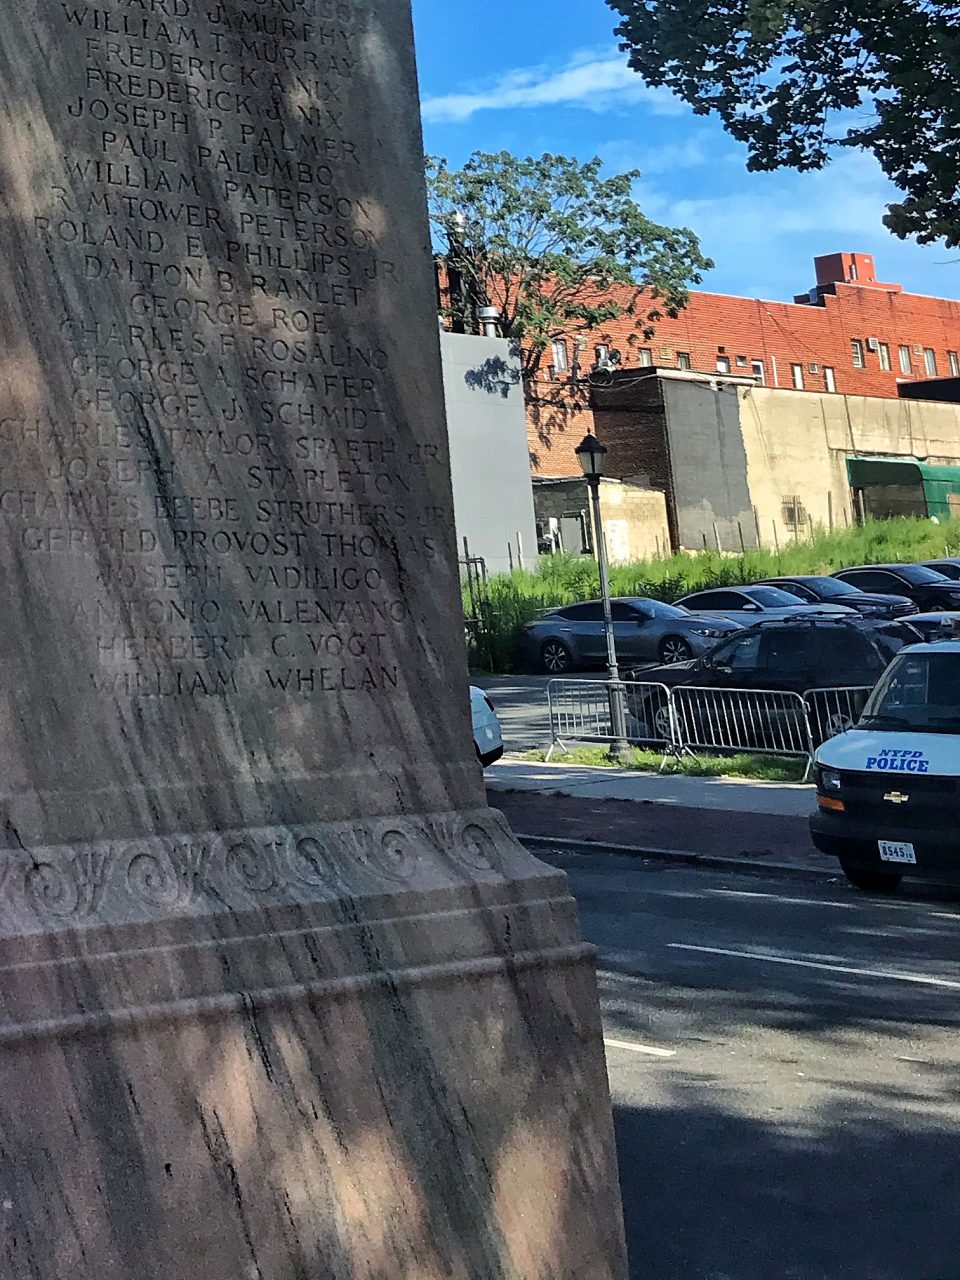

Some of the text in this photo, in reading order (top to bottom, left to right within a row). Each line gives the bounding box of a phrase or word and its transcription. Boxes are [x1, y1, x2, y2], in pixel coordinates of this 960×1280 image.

[60, 1, 200, 51] WILLIAM
[238, 37, 360, 82] MURRAY
[238, 9, 357, 54] MURPHY
[85, 36, 259, 90] FREDERICK
[295, 76, 342, 106] NIX
[85, 66, 254, 117] FREDERICK
[297, 104, 345, 133] NIX
[67, 94, 189, 134] JOSEPH
[239, 123, 361, 163] PALMER
[101, 131, 334, 188] PAUL PALUMBO
[63, 156, 371, 222] WILLIAM PATERSON
[34, 215, 164, 254] ROLAND
[225, 239, 351, 277] PHILLIPS
[122, 196, 225, 230] TOWER
[238, 213, 383, 253] PETERSON
[84, 253, 202, 290] DALTON
[251, 274, 365, 308] RANLET
[129, 292, 328, 334] GEORGE ROE
[58, 317, 205, 353] CHARLES
[251, 336, 390, 372] ROSALINO
[69, 351, 199, 385] GEORGE
[245, 366, 377, 401] SCHAFER
[72, 385, 202, 419] GEORGE
[259, 398, 386, 433] SCHMIDT
[164, 426, 278, 457] TAYLOR
[295, 432, 398, 465] SPAETH
[246, 464, 410, 497] STAPLETON
[153, 494, 243, 522] BEEBE
[255, 498, 407, 529] STRUTHERS
[173, 526, 308, 557] PROVOST
[95, 634, 256, 661] HERBERT
[306, 632, 388, 657] VOGT
[89, 665, 399, 697] WILLIAM WHELAN
[866, 757, 929, 772] POLICE
[879, 749, 923, 758] NYPD
